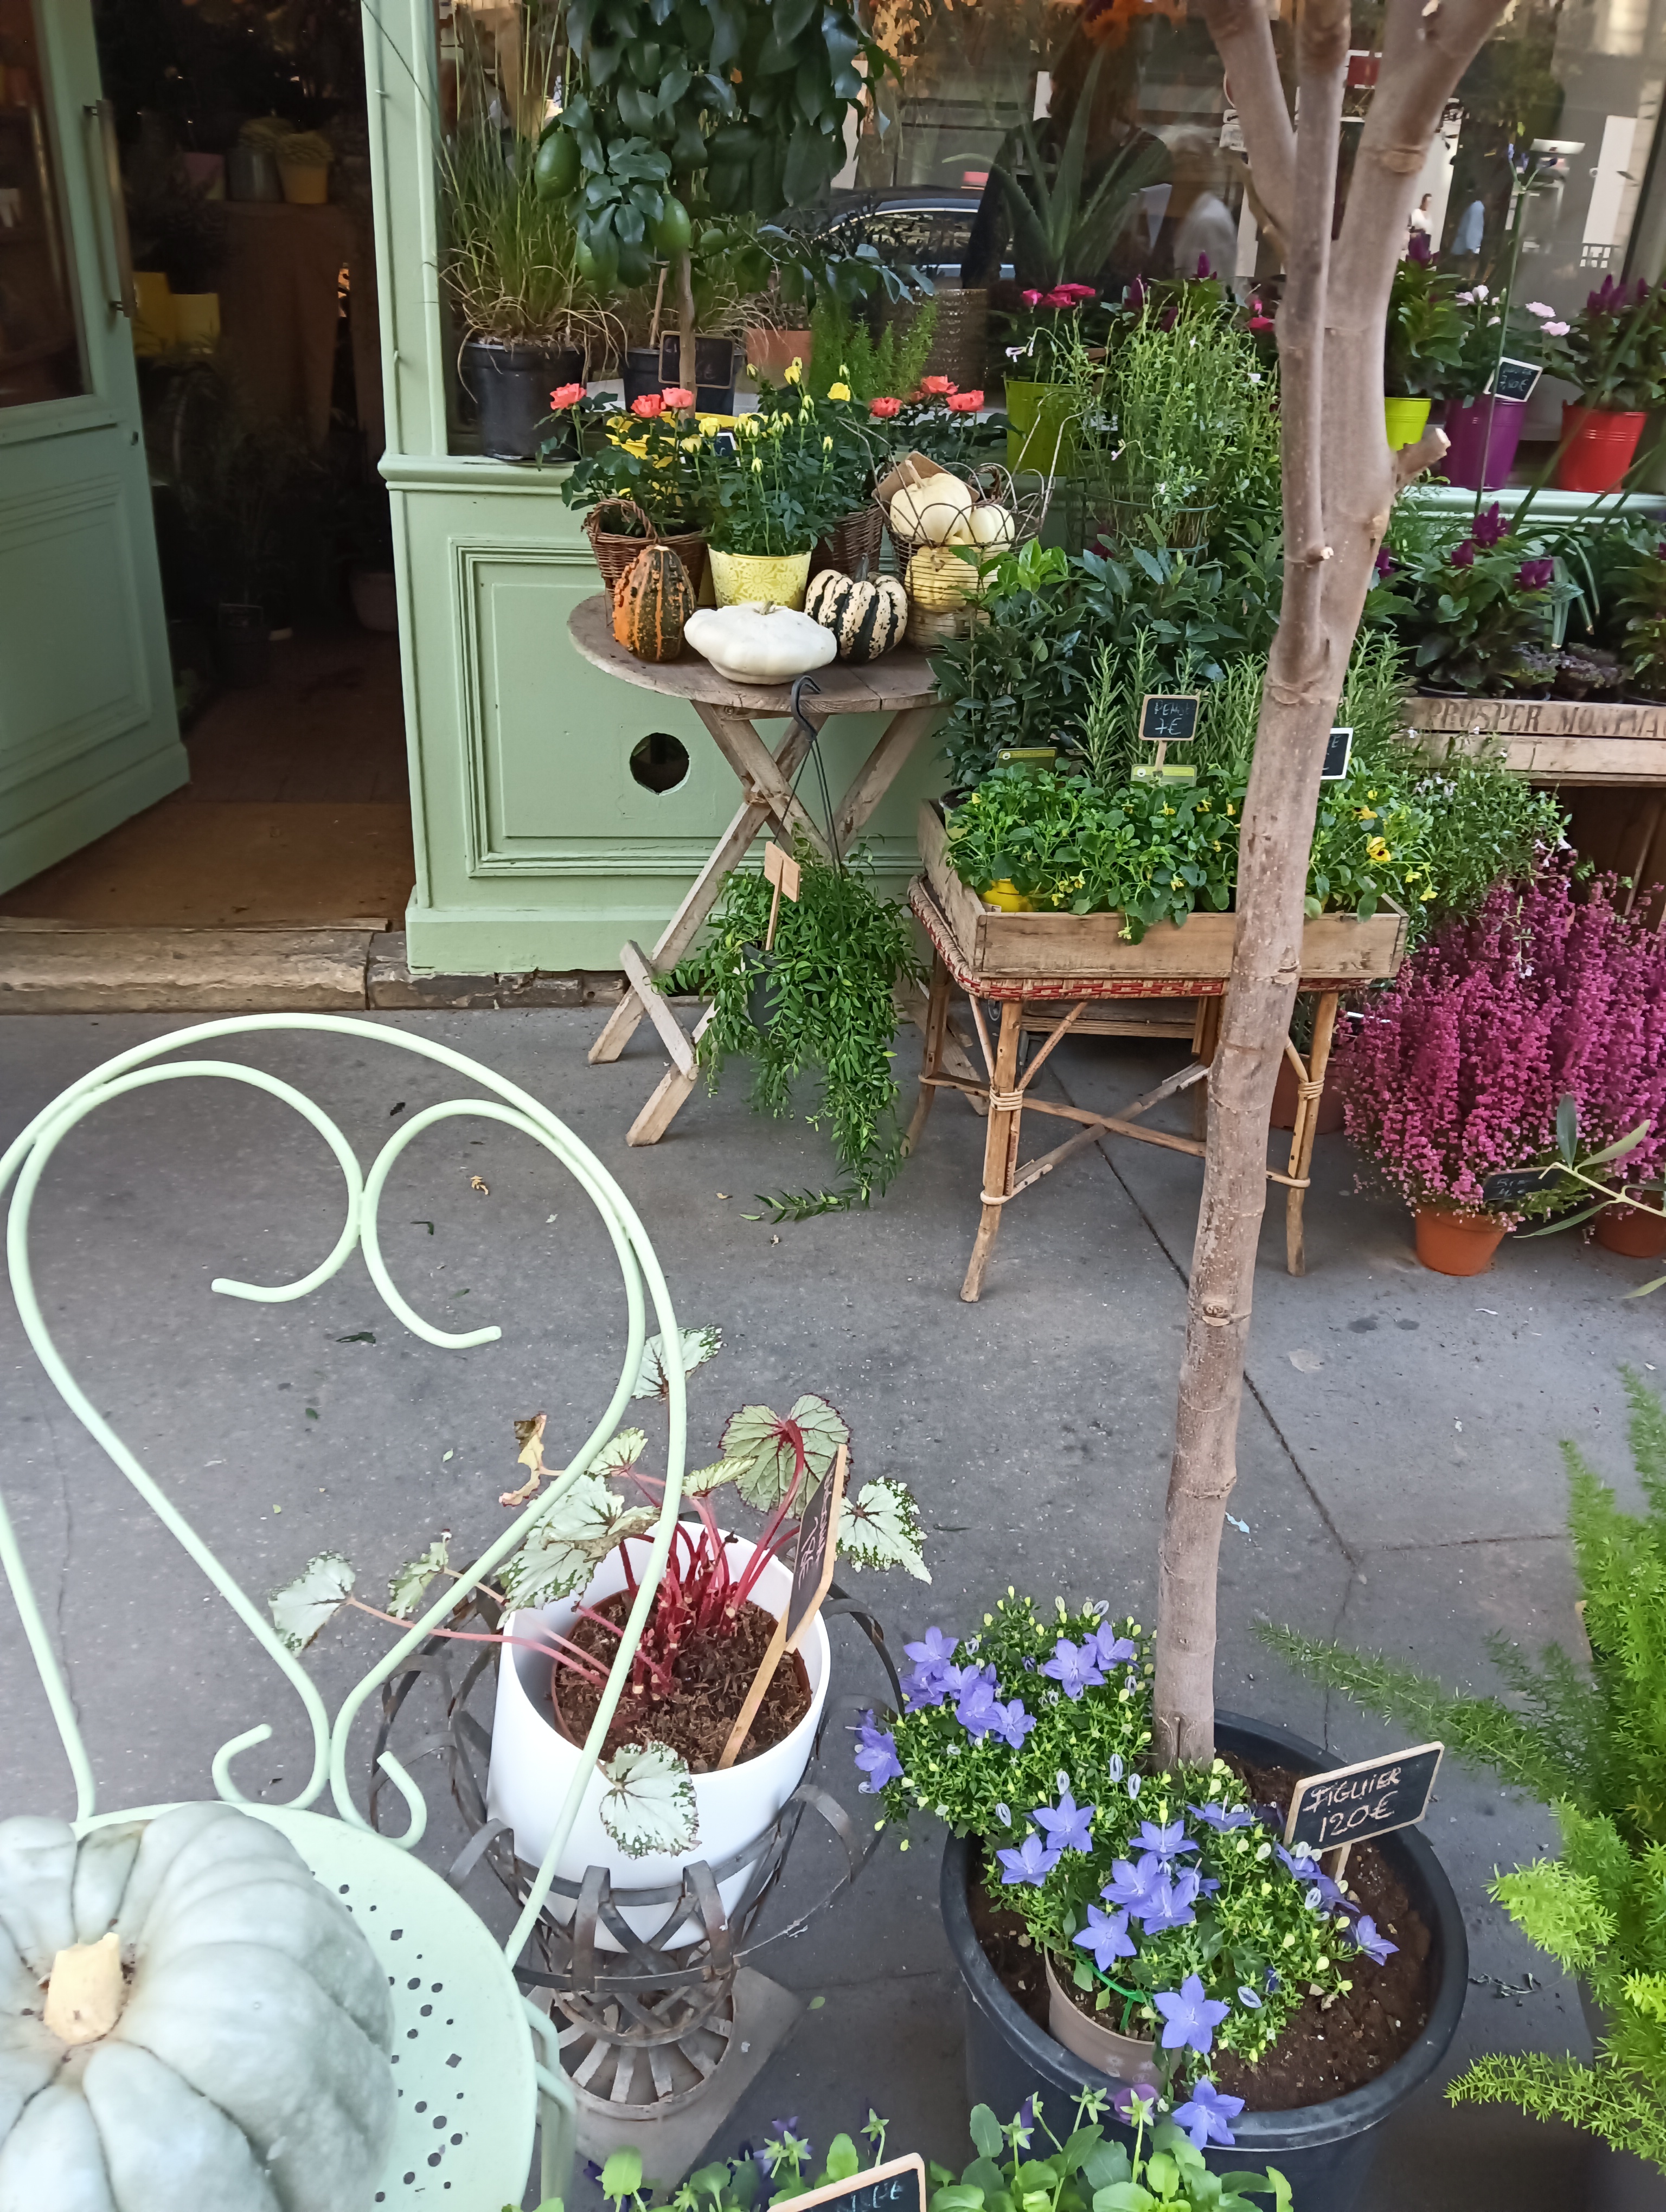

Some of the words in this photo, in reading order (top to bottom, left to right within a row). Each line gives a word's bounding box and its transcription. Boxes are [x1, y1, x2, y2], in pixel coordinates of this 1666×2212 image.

[1155, 717, 1182, 735] 7€
[1302, 1766, 1401, 1813] FIGUIER
[1318, 1790, 1399, 1843] 120€
